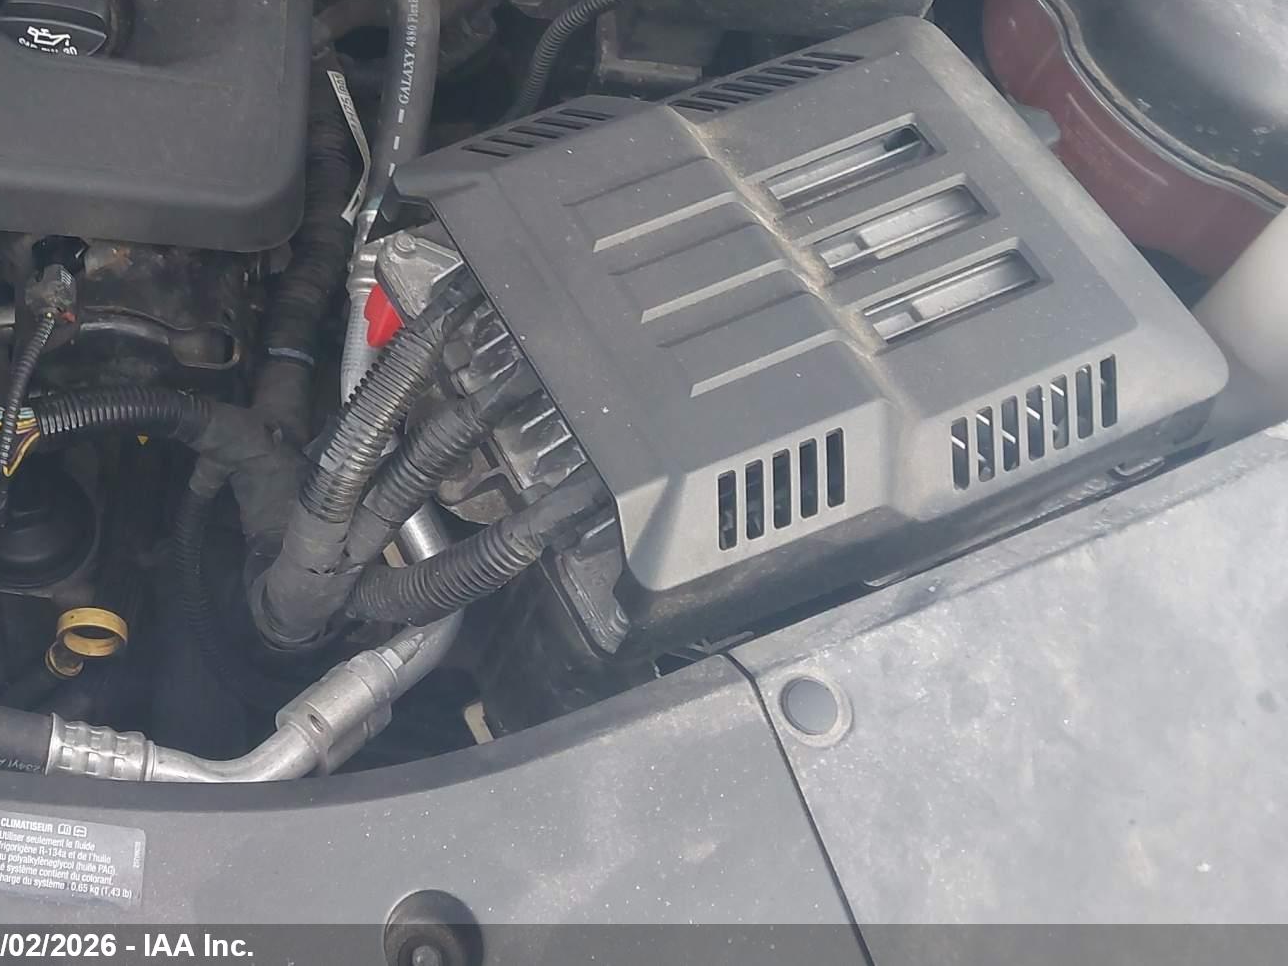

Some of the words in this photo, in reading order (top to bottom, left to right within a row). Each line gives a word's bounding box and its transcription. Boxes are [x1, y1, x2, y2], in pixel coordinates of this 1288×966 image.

[399, 48, 416, 105] GALAXY
[0, 817, 52, 832] CLIMATISEUR
[25, 833, 63, 846] seulement
[65, 839, 73, 847] le
[74, 840, 94, 850] fluide
[38, 846, 66, 857] R-134a
[68, 850, 76, 858] et
[77, 851, 87, 860] de
[35, 866, 68, 878] contient
[70, 871, 80, 880] du
[81, 872, 113, 884] colorant.
[75, 861, 96, 873] (huile
[22, 876, 32, 885] du
[89, 885, 99, 895] kg
[122, 889, 131, 899] lb)
